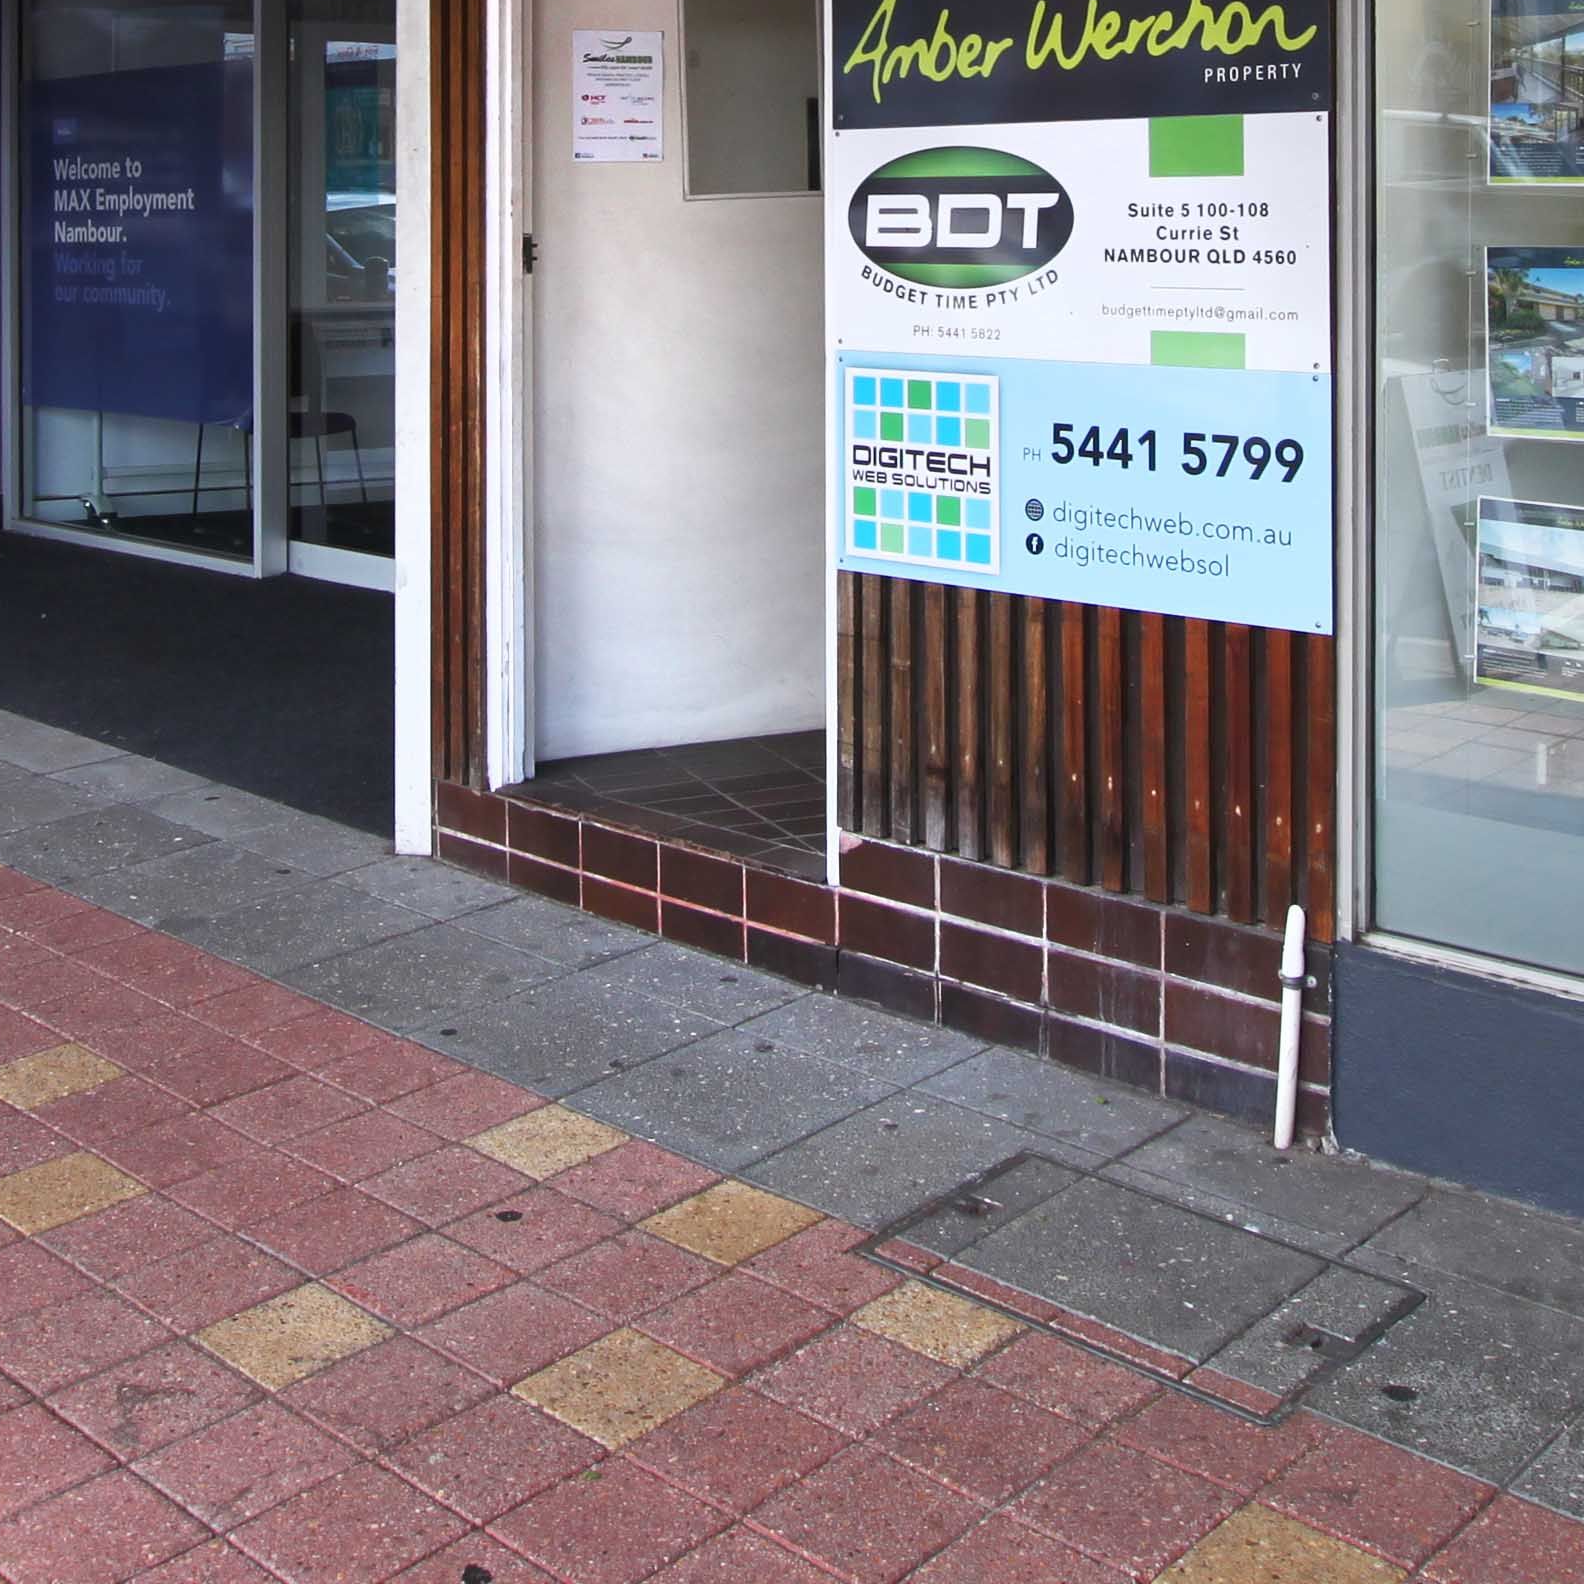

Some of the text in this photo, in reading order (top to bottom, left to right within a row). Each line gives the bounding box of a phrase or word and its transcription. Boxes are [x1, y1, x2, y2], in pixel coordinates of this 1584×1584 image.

[1204, 63, 1302, 83] PROPERTY
[54, 156, 142, 180] Welcome to
[54, 188, 195, 216] MAX Employment
[1128, 203, 1270, 219] Suite 5 100-108
[54, 220, 127, 243] Nambour.
[865, 192, 1060, 250] BDT
[1156, 225, 1240, 242] Currie St
[55, 251, 144, 281] Working for
[1104, 249, 1298, 266] NAMBOUR QLD 4560
[55, 282, 172, 312] our community.
[860, 265, 1060, 310] BUDGET TIME PTY LTD
[1102, 304, 1298, 322] budgettimeptyltd@gmail.com
[913, 325, 934, 339] PH:
[937, 326, 967, 340] 5441
[852, 445, 991, 478] DIGITECH
[1023, 423, 1304, 483] PH 5441 5799
[852, 469, 991, 496] WEB SOLUTIONS
[1053, 500, 1293, 549] digitechweb.com.au
[1054, 537, 1230, 578] digitechwebsol
